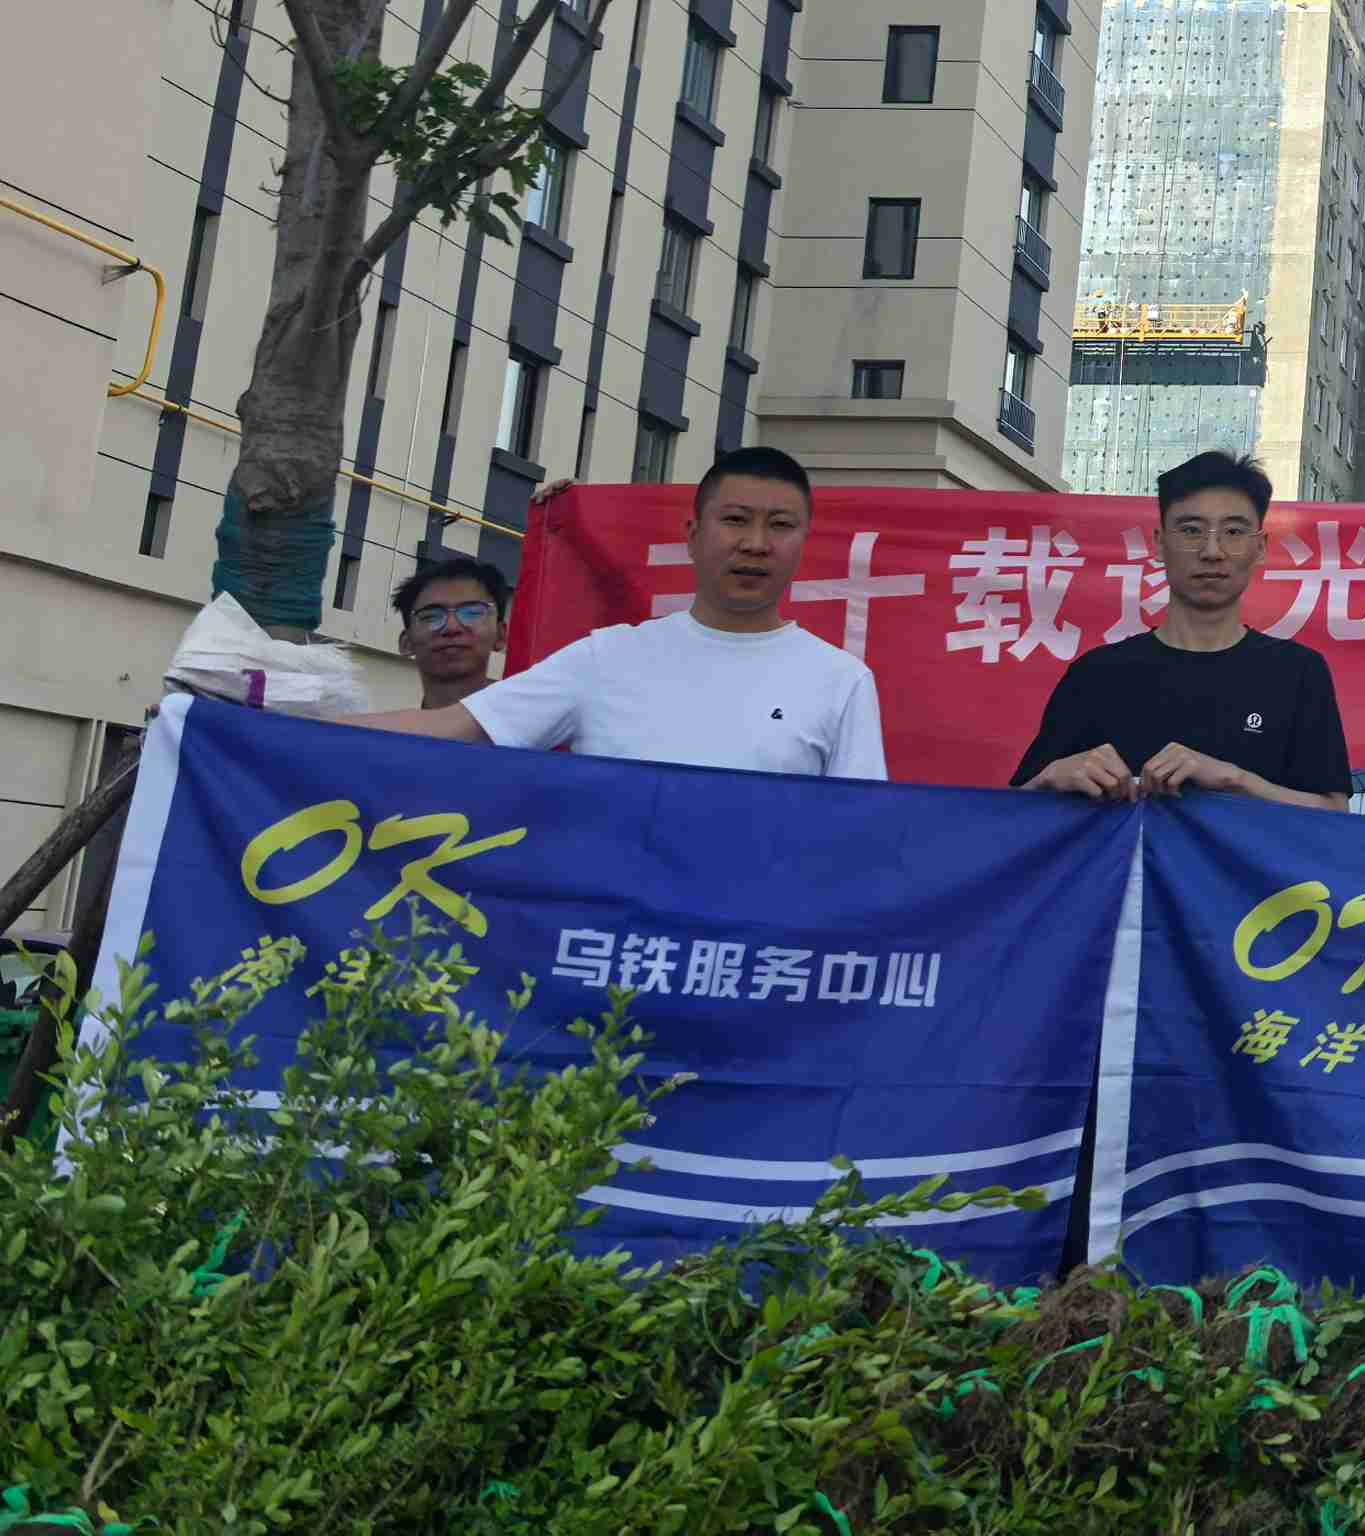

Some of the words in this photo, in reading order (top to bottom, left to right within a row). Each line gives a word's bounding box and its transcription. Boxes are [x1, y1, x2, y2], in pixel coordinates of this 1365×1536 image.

[242, 800, 528, 937] OK
[550, 927, 940, 1009] 乌铁服务中心
